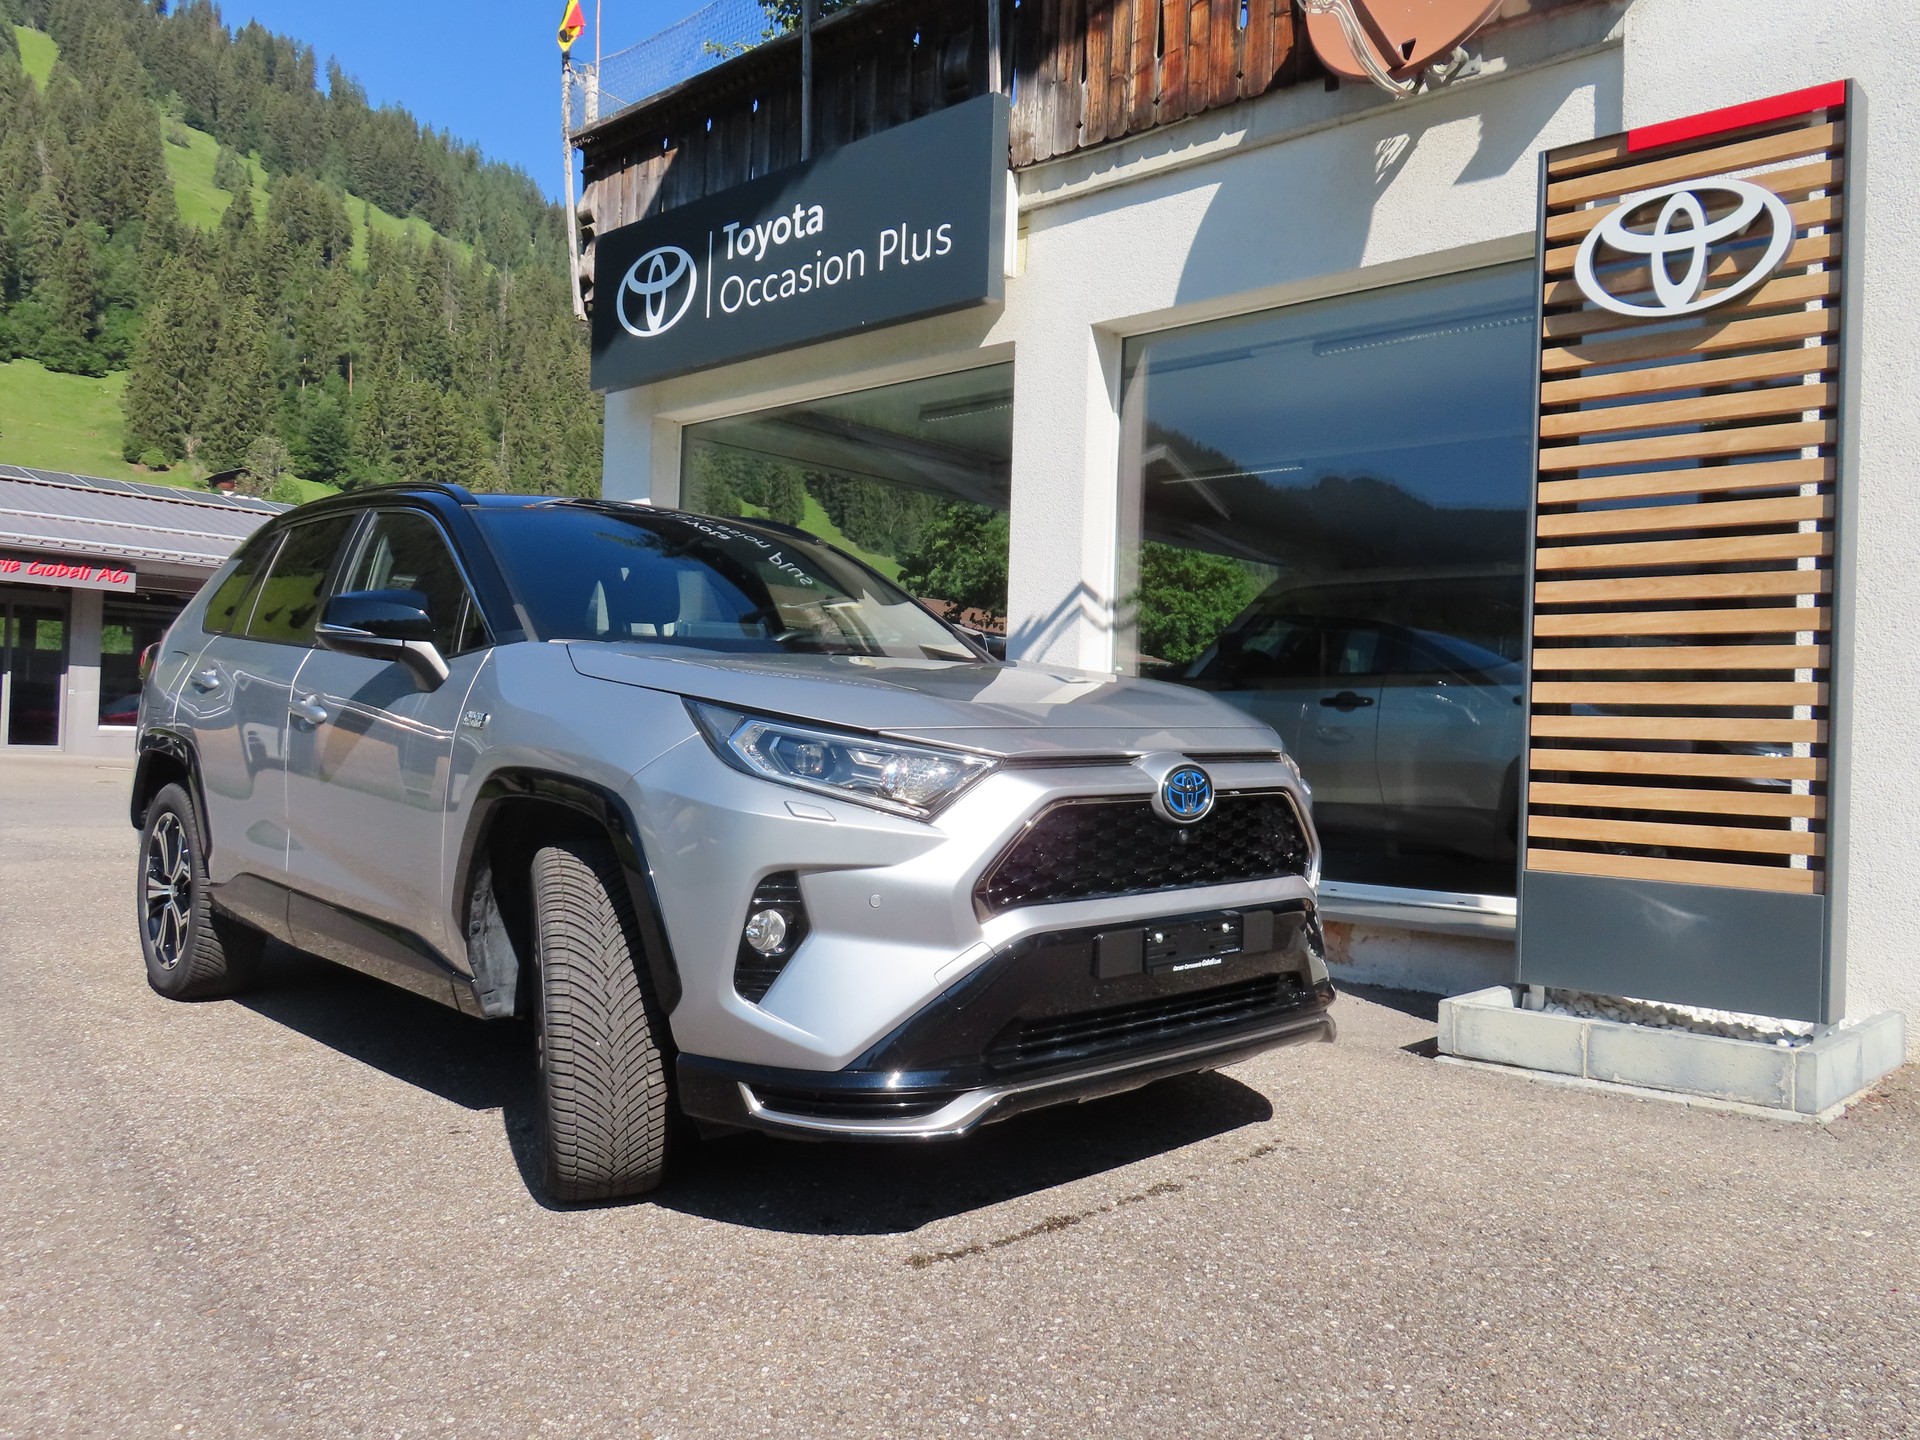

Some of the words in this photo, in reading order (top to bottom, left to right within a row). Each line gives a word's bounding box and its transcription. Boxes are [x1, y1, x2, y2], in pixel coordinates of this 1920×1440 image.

[723, 203, 824, 262] Toyota
[720, 249, 865, 313] Occasion
[879, 222, 952, 271] Plus
[26, 560, 91, 580] Gobeli
[95, 567, 129, 584] AG
